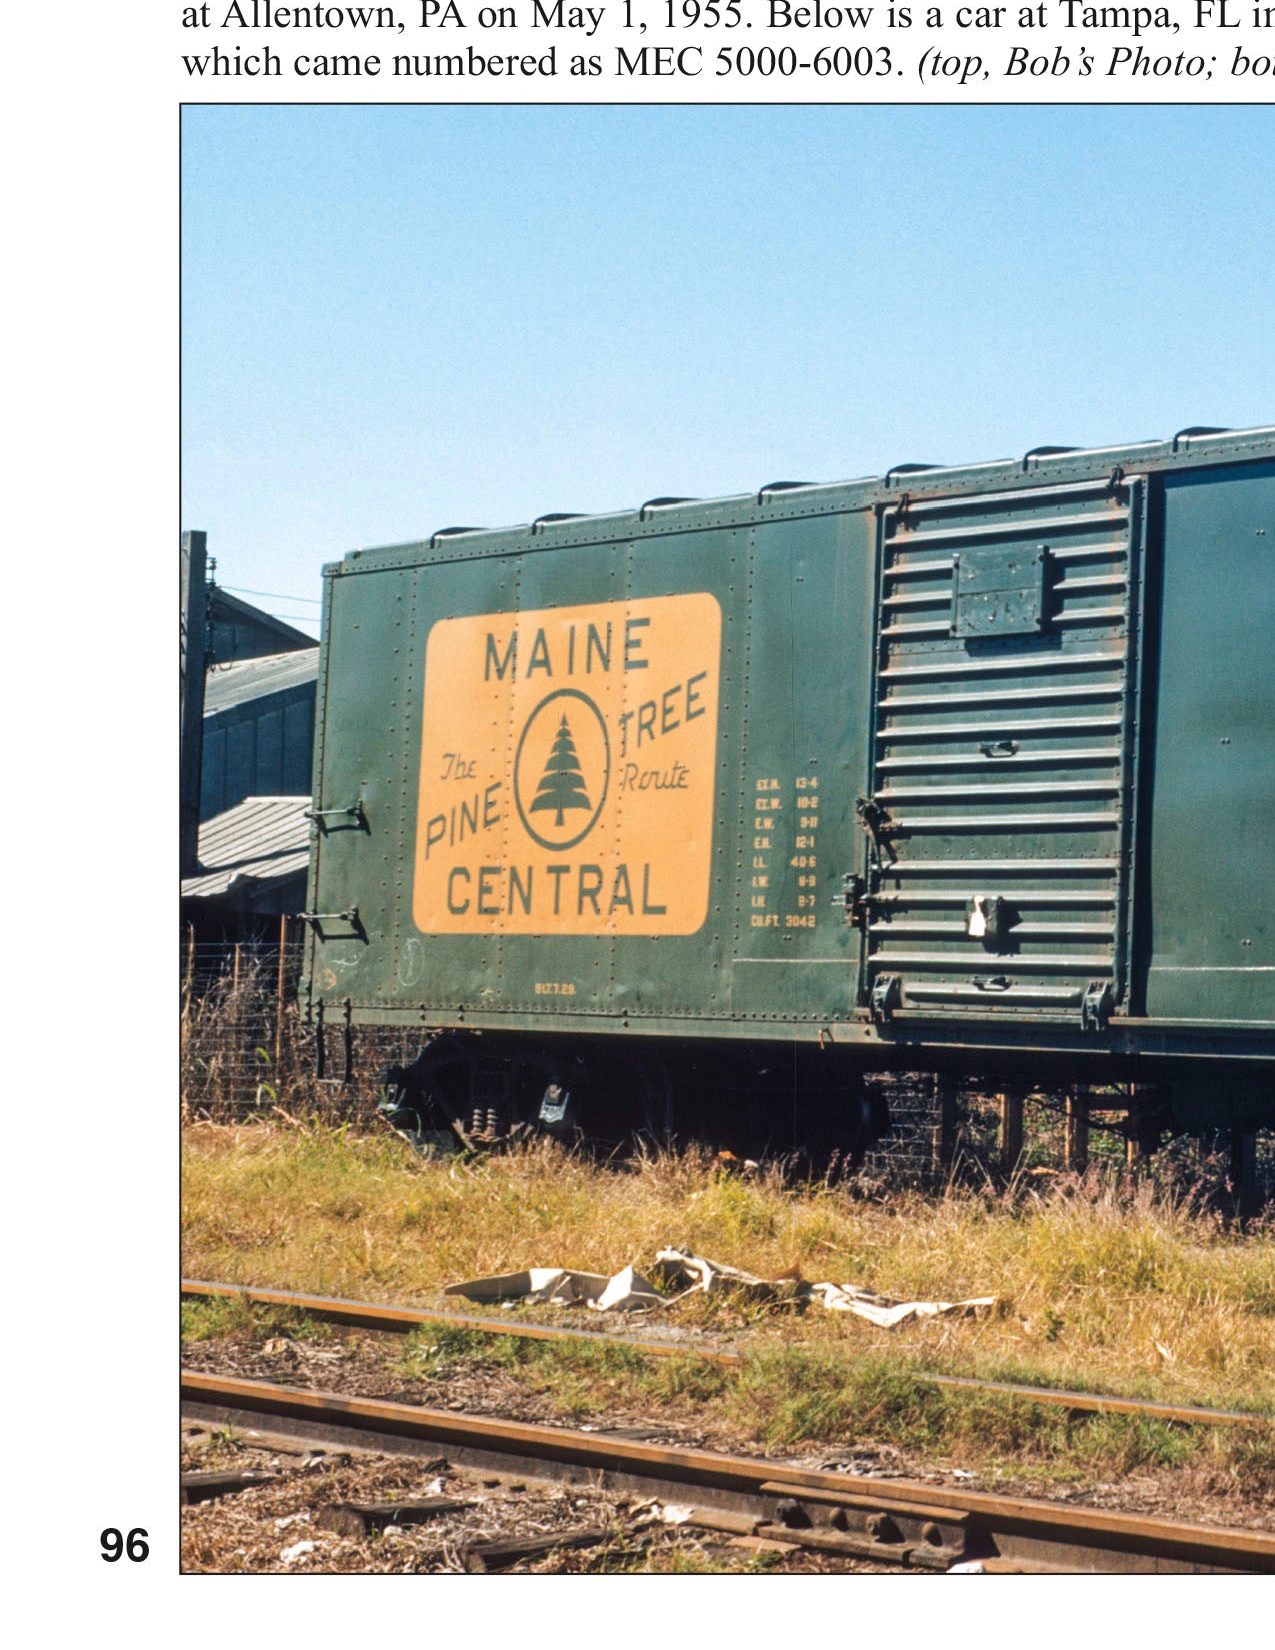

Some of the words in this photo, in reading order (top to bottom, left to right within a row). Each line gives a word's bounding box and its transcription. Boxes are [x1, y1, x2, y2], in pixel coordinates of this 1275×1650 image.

[483, 617, 651, 682] MAINE
[618, 670, 708, 756] TREE
[439, 752, 478, 781] The
[620, 760, 690, 792] Route
[425, 781, 502, 861] PINE
[446, 862, 668, 916] CENTRAL
